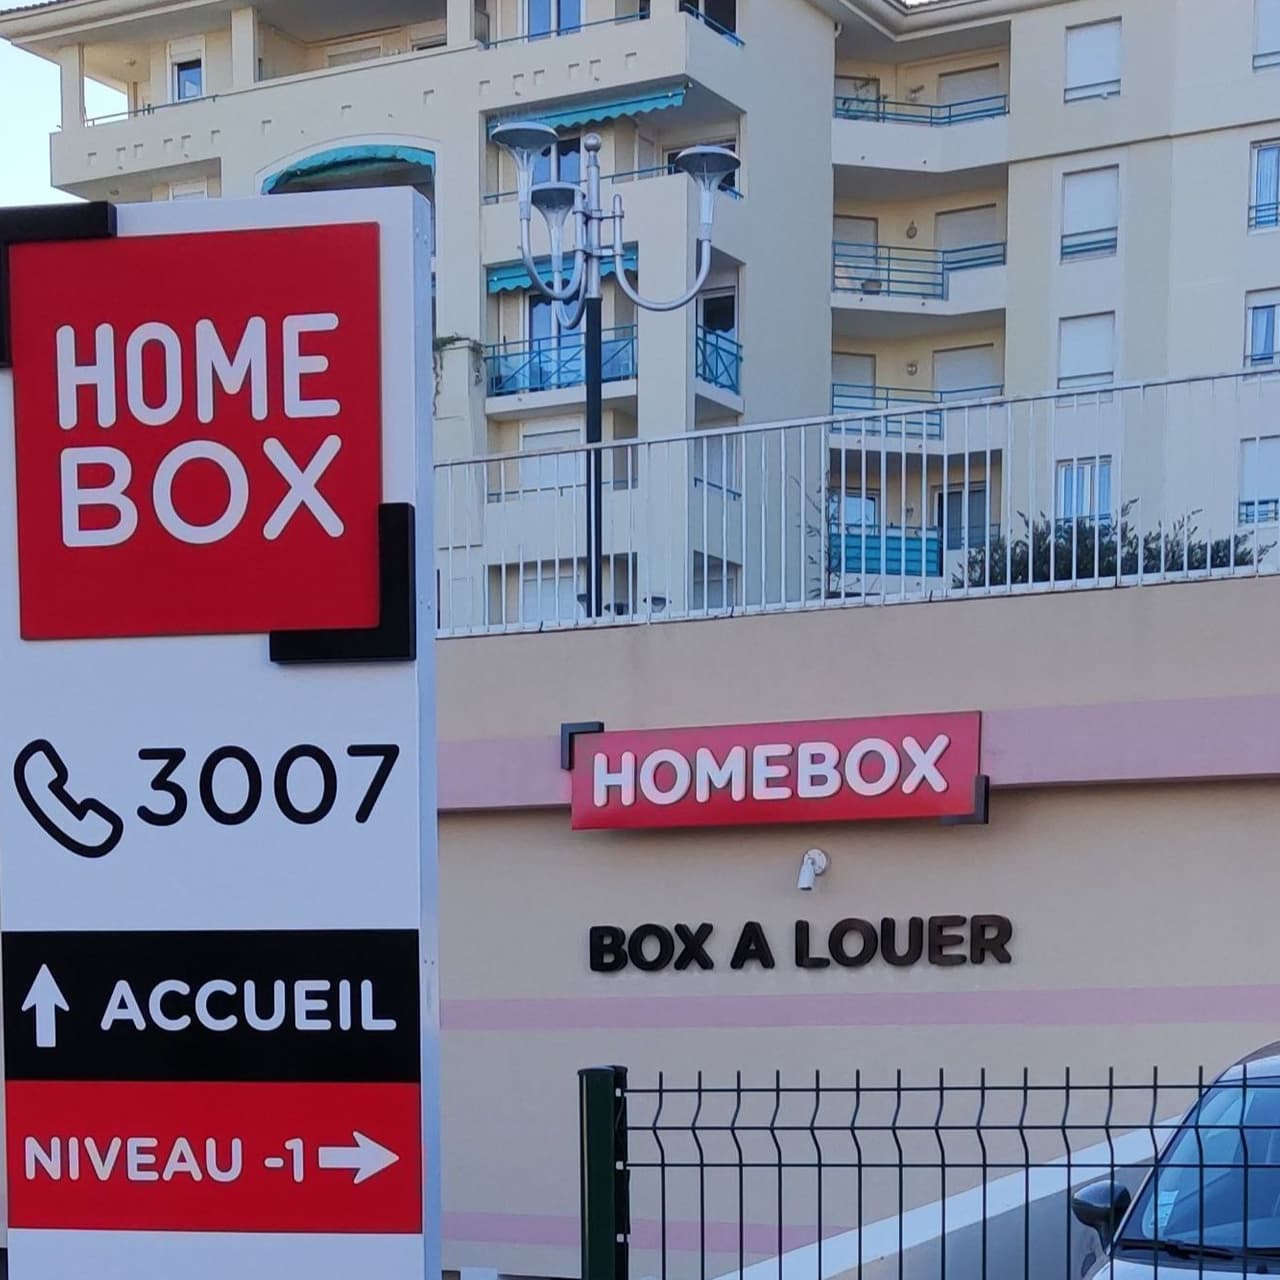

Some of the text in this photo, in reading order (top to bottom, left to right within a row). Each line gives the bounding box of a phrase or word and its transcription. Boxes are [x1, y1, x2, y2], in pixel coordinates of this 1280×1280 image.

[55, 312, 340, 431] HOME
[60, 434, 345, 549] BOX
[137, 743, 400, 827] 3007
[592, 733, 951, 808] HOMEBOX
[589, 914, 1013, 973] BOX A LOUER
[100, 978, 397, 1032] ACCUEIL
[24, 1135, 305, 1184] NIVEAU -1
